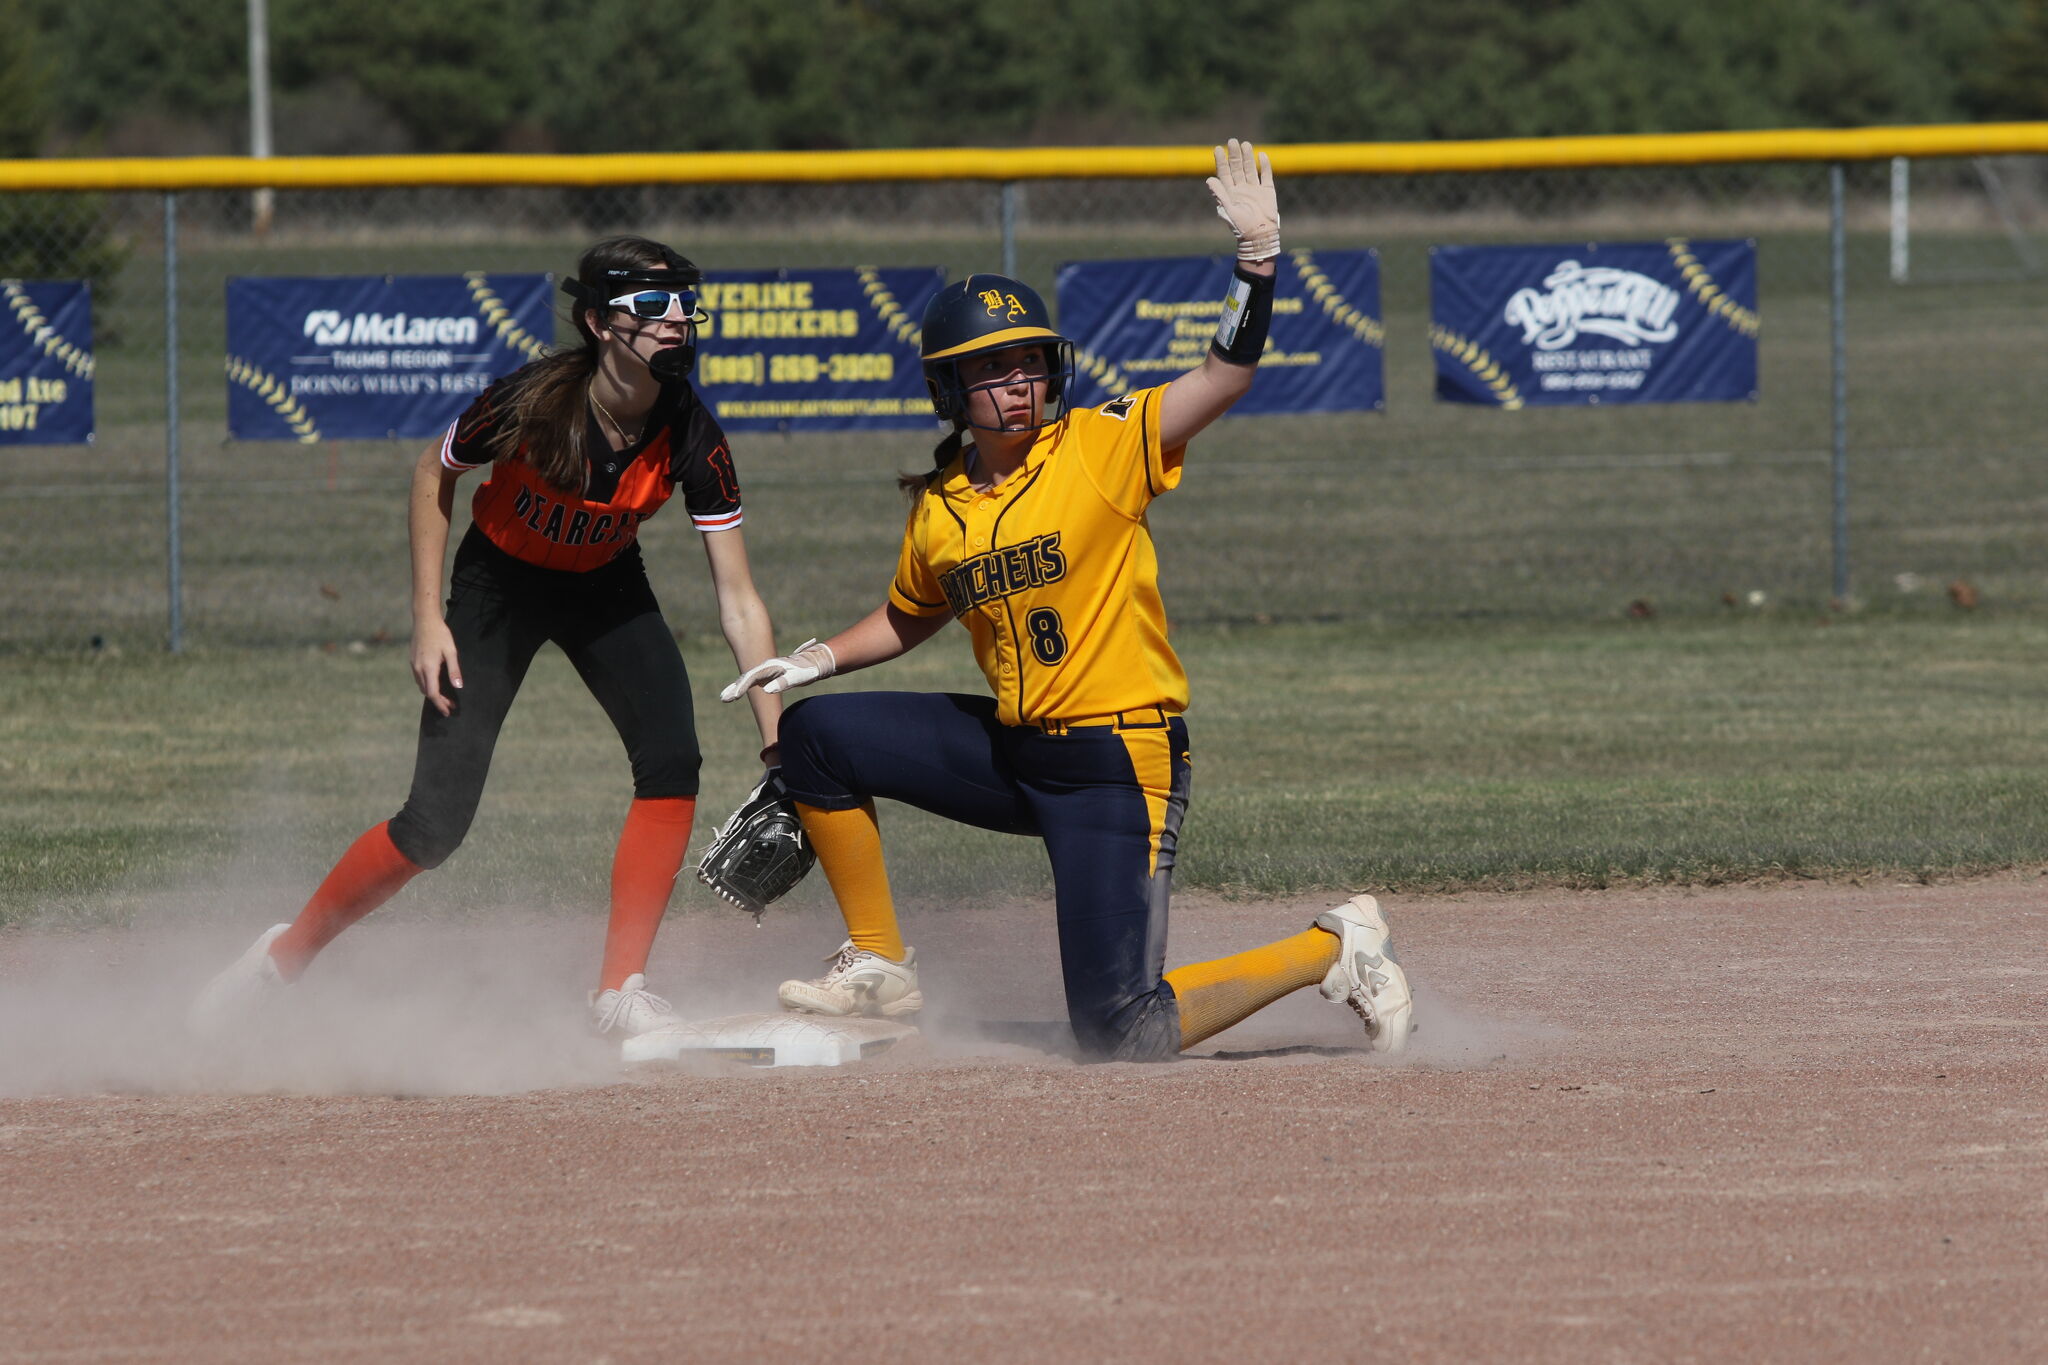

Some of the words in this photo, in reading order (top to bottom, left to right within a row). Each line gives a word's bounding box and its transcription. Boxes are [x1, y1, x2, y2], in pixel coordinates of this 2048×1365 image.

[689, 282, 813, 310] VERINE
[351, 312, 478, 345] McLaren
[721, 310, 858, 338] BROKERS
[332, 350, 389, 369] THUMB
[391, 350, 453, 369] REGION
[291, 374, 360, 395] DOING
[362, 373, 438, 395] WHAT'S
[440, 372, 491, 394] BEST
[1026, 606, 1068, 667] 8
